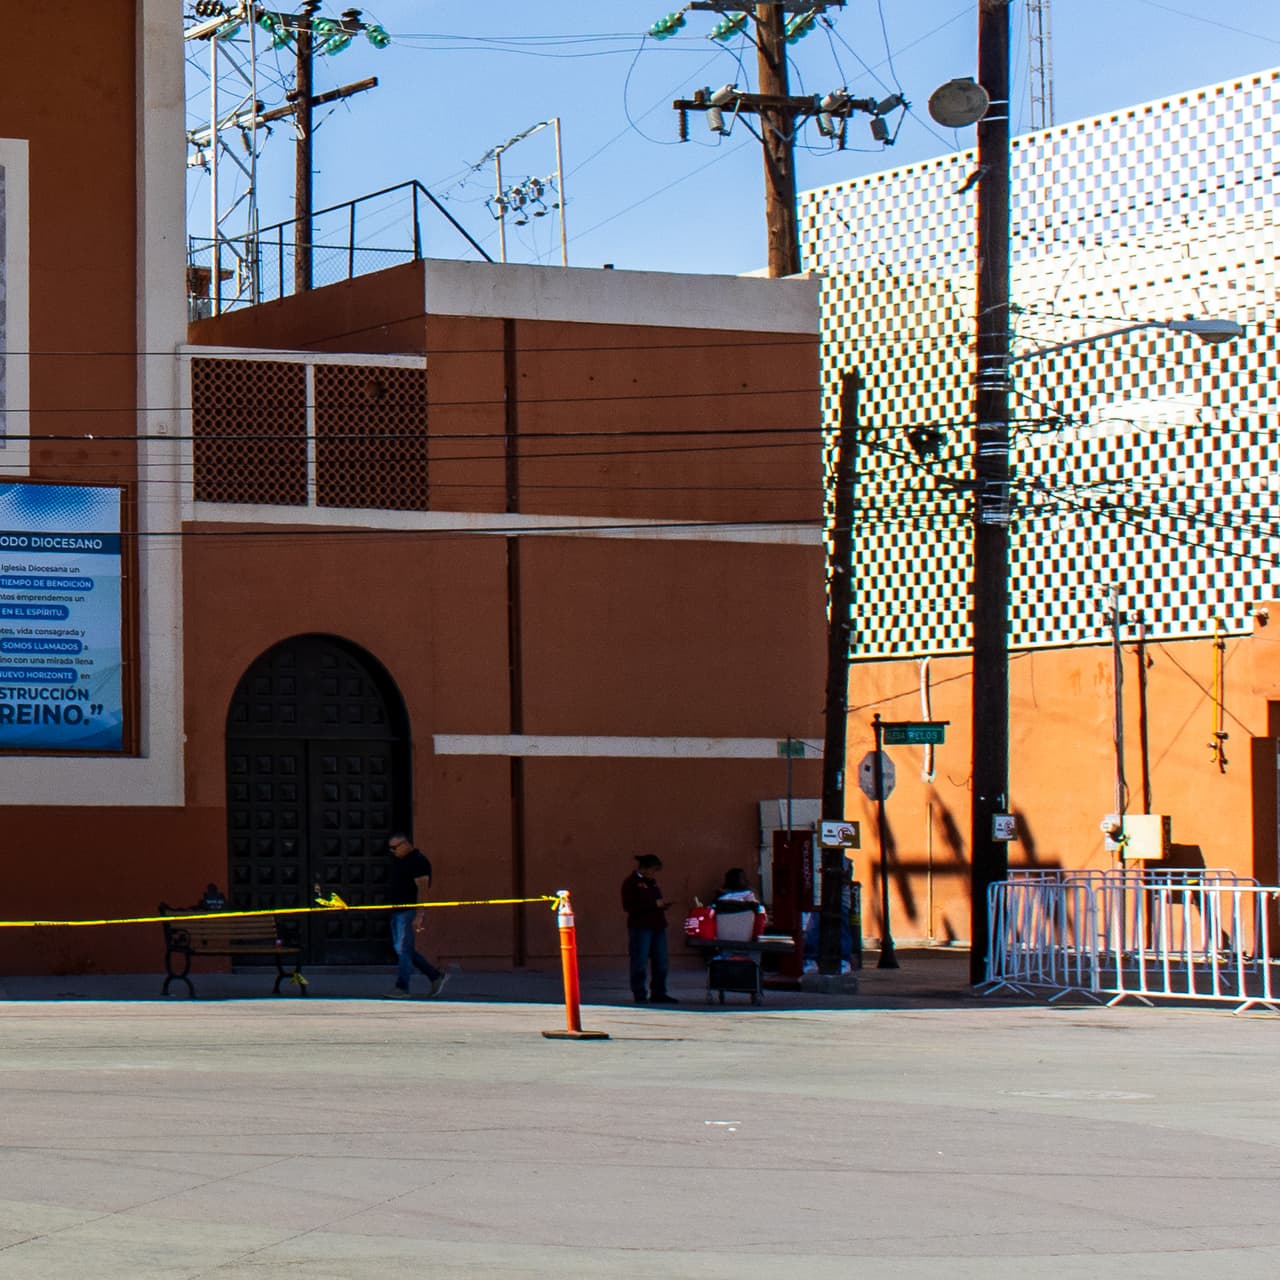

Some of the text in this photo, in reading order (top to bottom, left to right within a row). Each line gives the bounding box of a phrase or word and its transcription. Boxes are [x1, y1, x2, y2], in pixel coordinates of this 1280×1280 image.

[31, 537, 103, 550] DIOCESANO
[1, 564, 27, 573] Iglesia
[28, 564, 68, 573] Diocesana
[0, 578, 31, 587] TIEMPO
[32, 579, 45, 587] DE
[16, 593, 73, 602] emprendemos
[2, 607, 14, 616] EN
[15, 608, 25, 616] EL
[16, 627, 33, 635] vida
[35, 628, 80, 637] consagrada
[80, 629, 86, 638] y
[2, 642, 33, 650] SOMOS
[34, 643, 79, 651] LLAMADOS
[13, 657, 29, 665] con
[46, 657, 74, 665] mirada
[75, 657, 94, 665] llena
[26, 672, 73, 680] HORIZONTE
